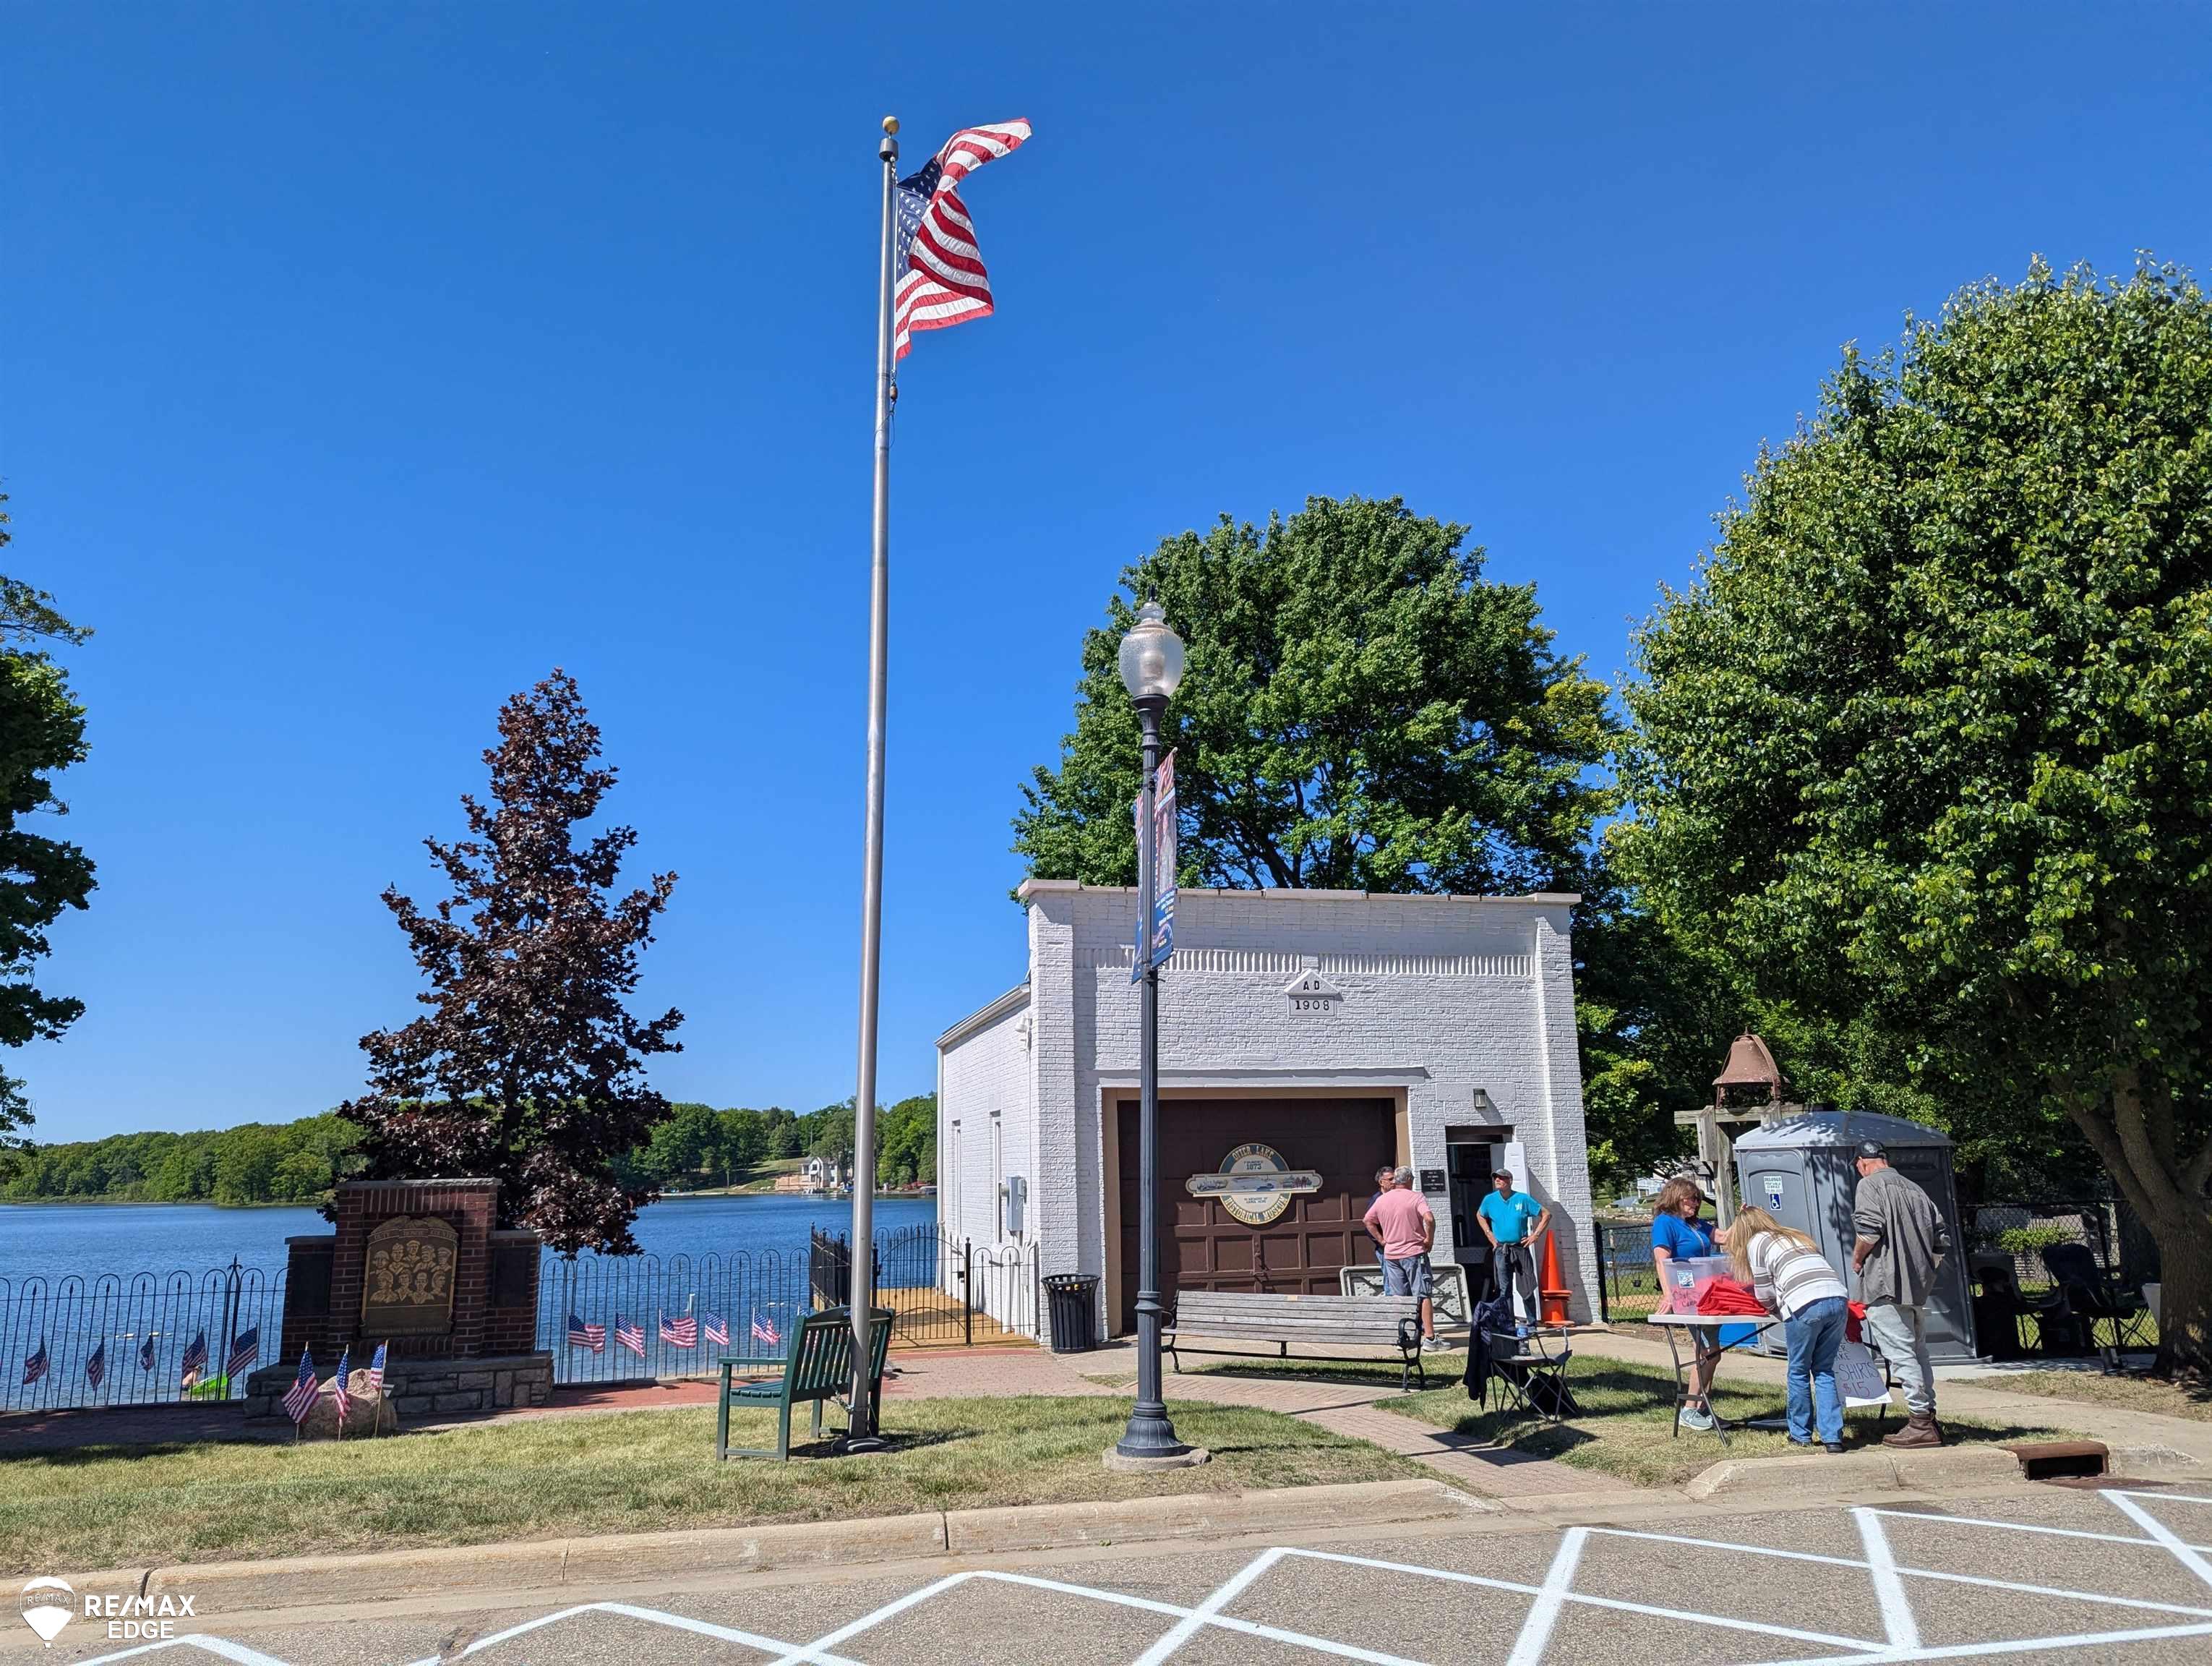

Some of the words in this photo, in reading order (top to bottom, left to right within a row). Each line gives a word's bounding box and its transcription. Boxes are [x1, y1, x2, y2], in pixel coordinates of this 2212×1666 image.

[1295, 1000, 1329, 1011] 1908
[1232, 1146, 1252, 1161] OTTER
[1256, 1145, 1274, 1160] LAKE
[1225, 1197, 1260, 1222] HISTORICAL
[1263, 1195, 1288, 1220] MUSEUM
[1843, 1382, 1870, 1398] $15
